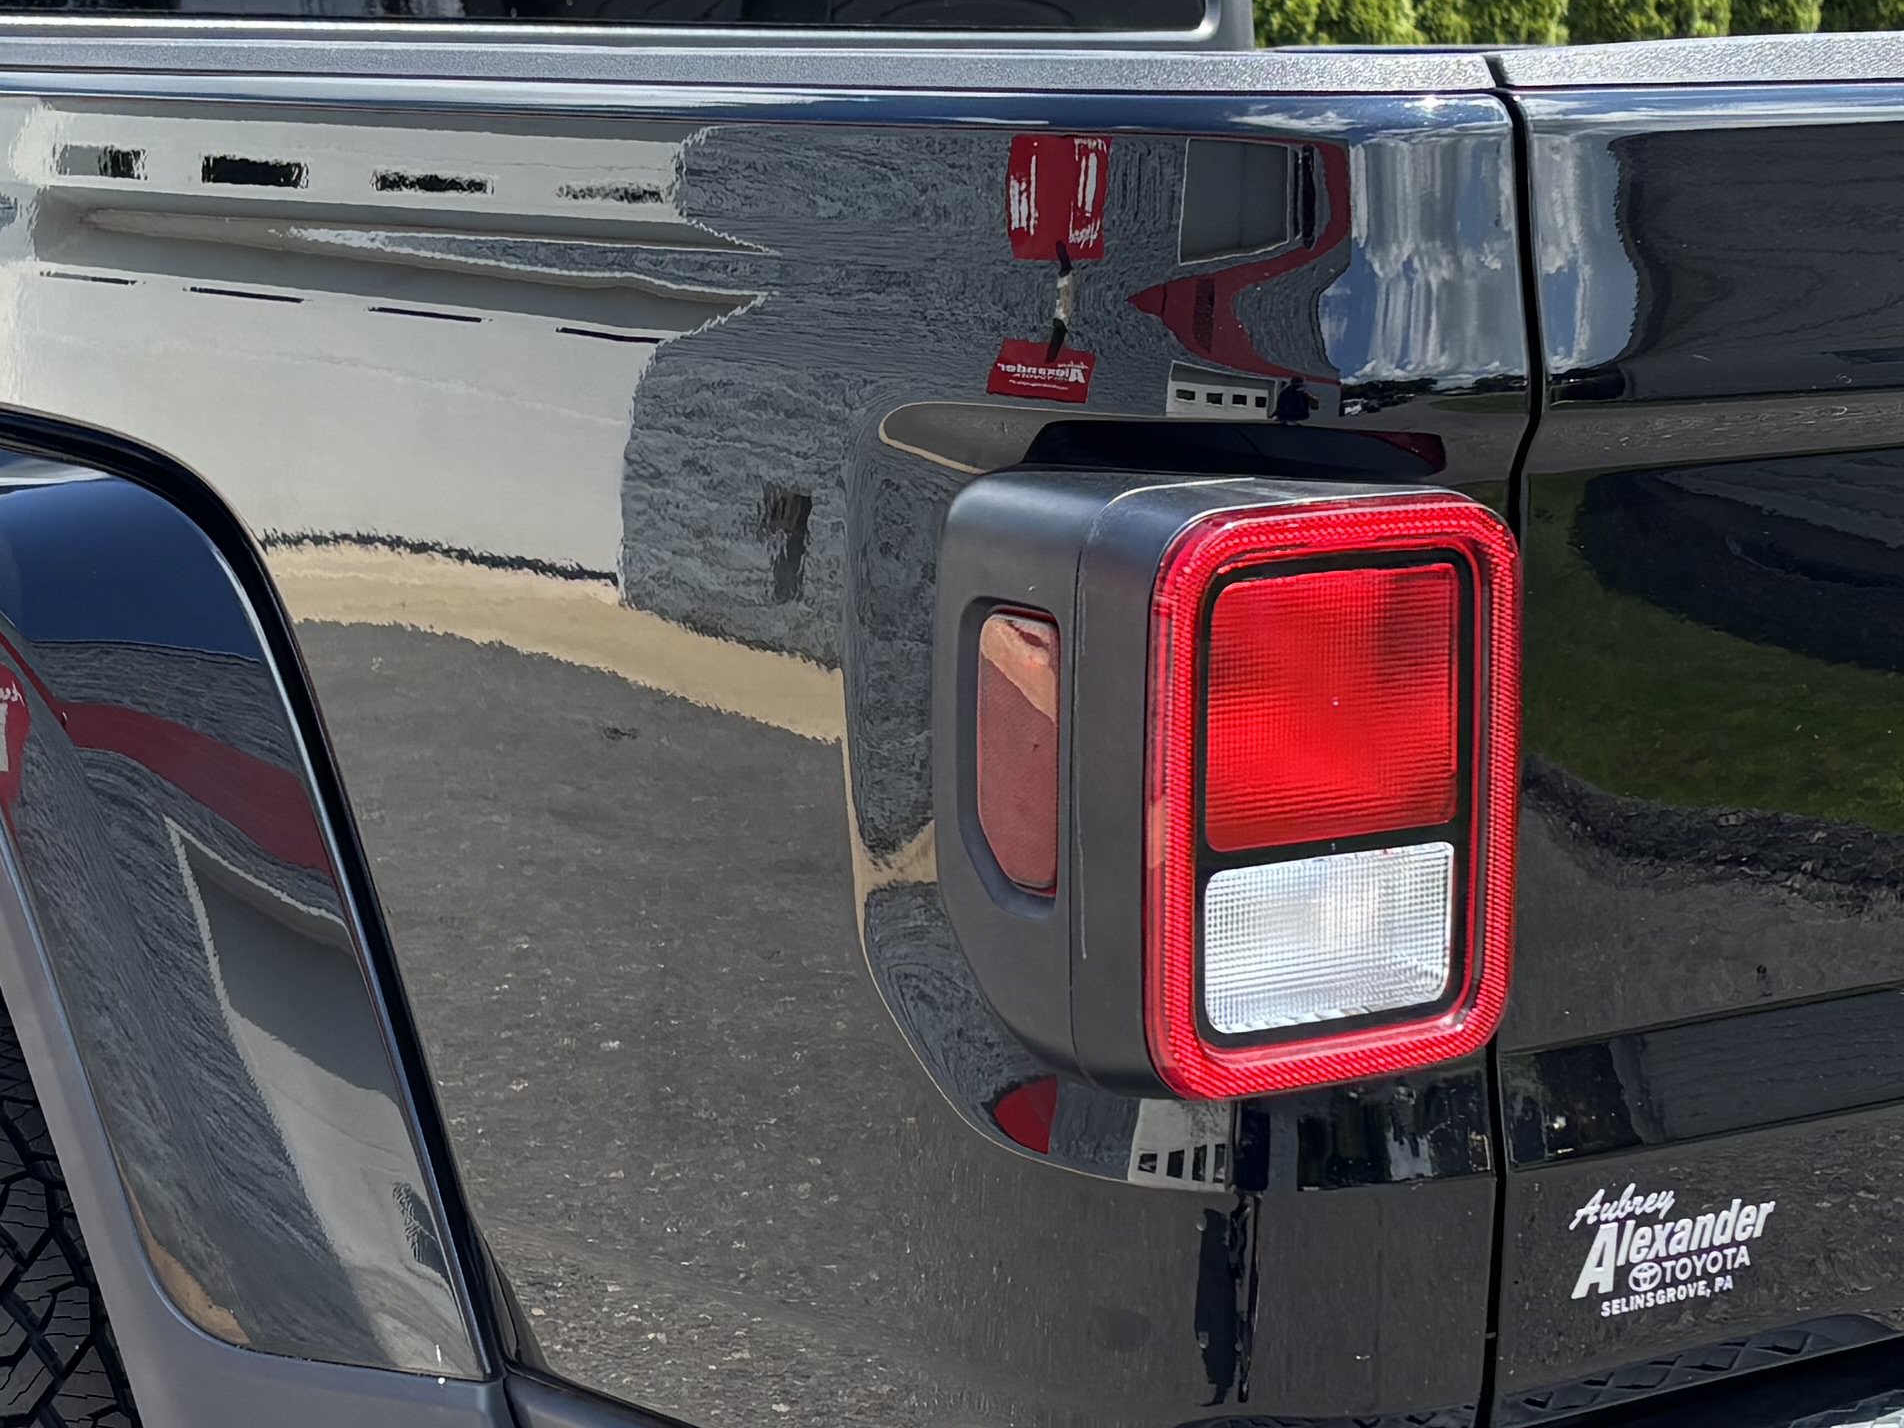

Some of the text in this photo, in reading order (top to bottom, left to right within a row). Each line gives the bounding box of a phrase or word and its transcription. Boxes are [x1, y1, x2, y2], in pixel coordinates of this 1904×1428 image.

[1569, 1183, 1676, 1231] Aubrey
[1571, 1198, 1776, 1300] Alexander
[1662, 1245, 1751, 1284] TOYOTA
[1601, 1275, 1734, 1318] SELINSGROVE, PA
